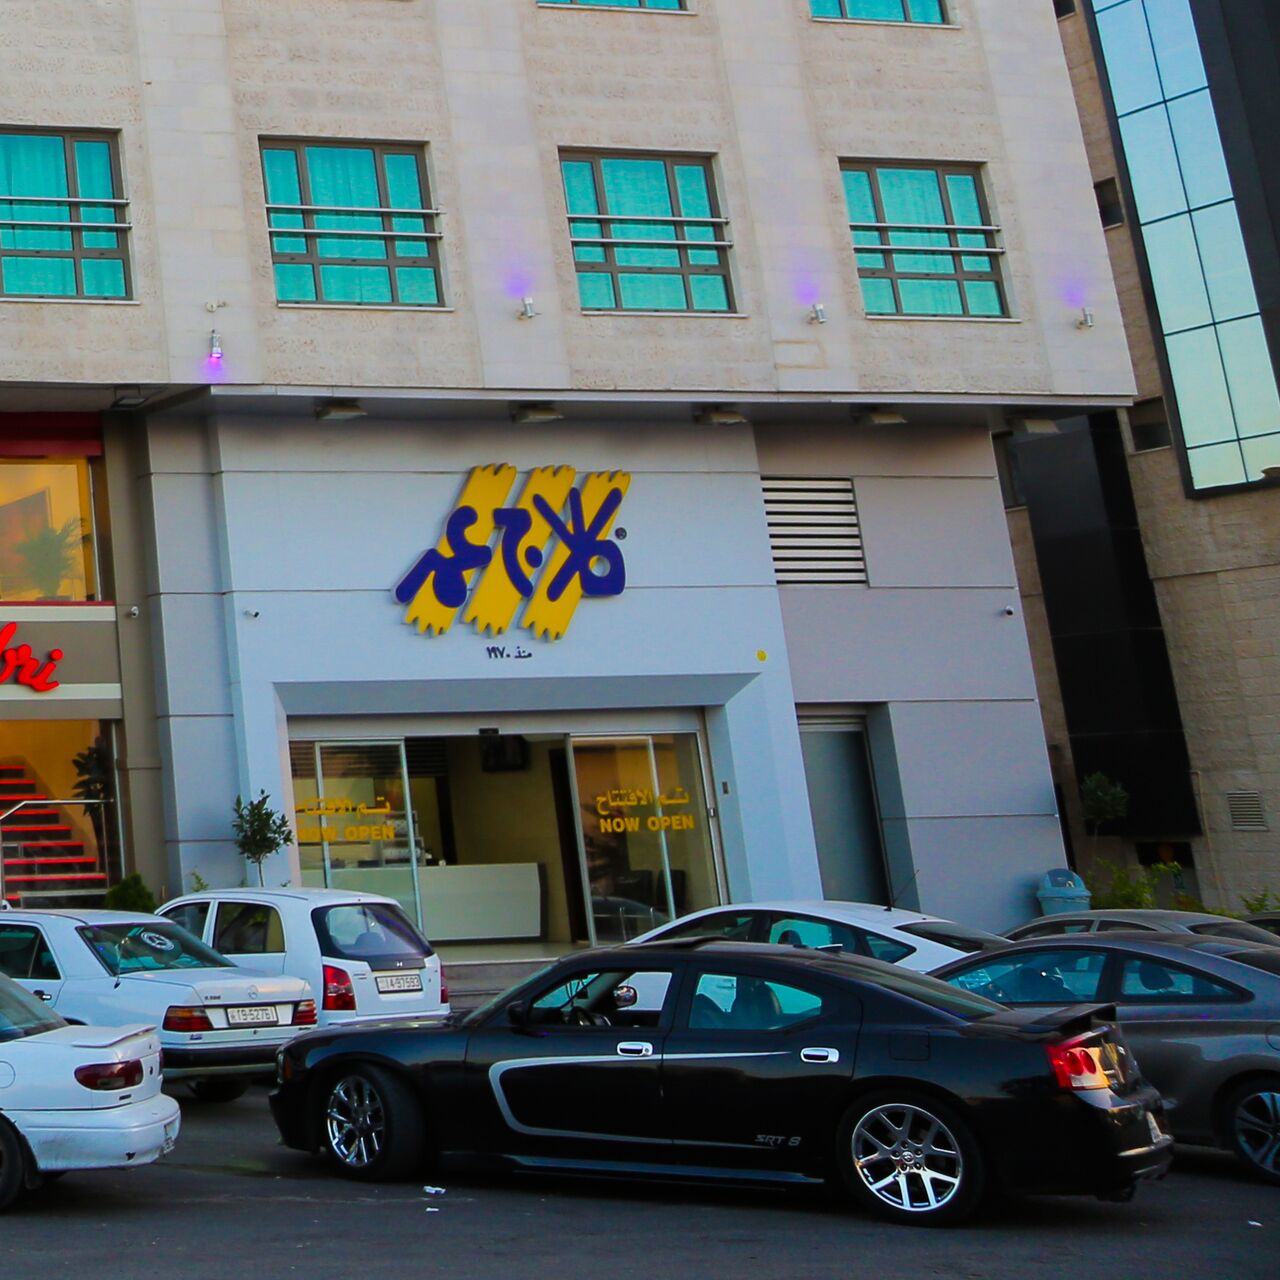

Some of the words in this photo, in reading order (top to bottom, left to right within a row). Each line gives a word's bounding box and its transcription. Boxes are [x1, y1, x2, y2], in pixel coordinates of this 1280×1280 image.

[514, 646, 533, 659] منذ
[599, 817, 640, 833] NOW
[647, 815, 696, 831] OPEN
[344, 824, 396, 841] OPEN
[754, 1134, 786, 1146] SRT
[789, 1136, 801, 1147] 8
